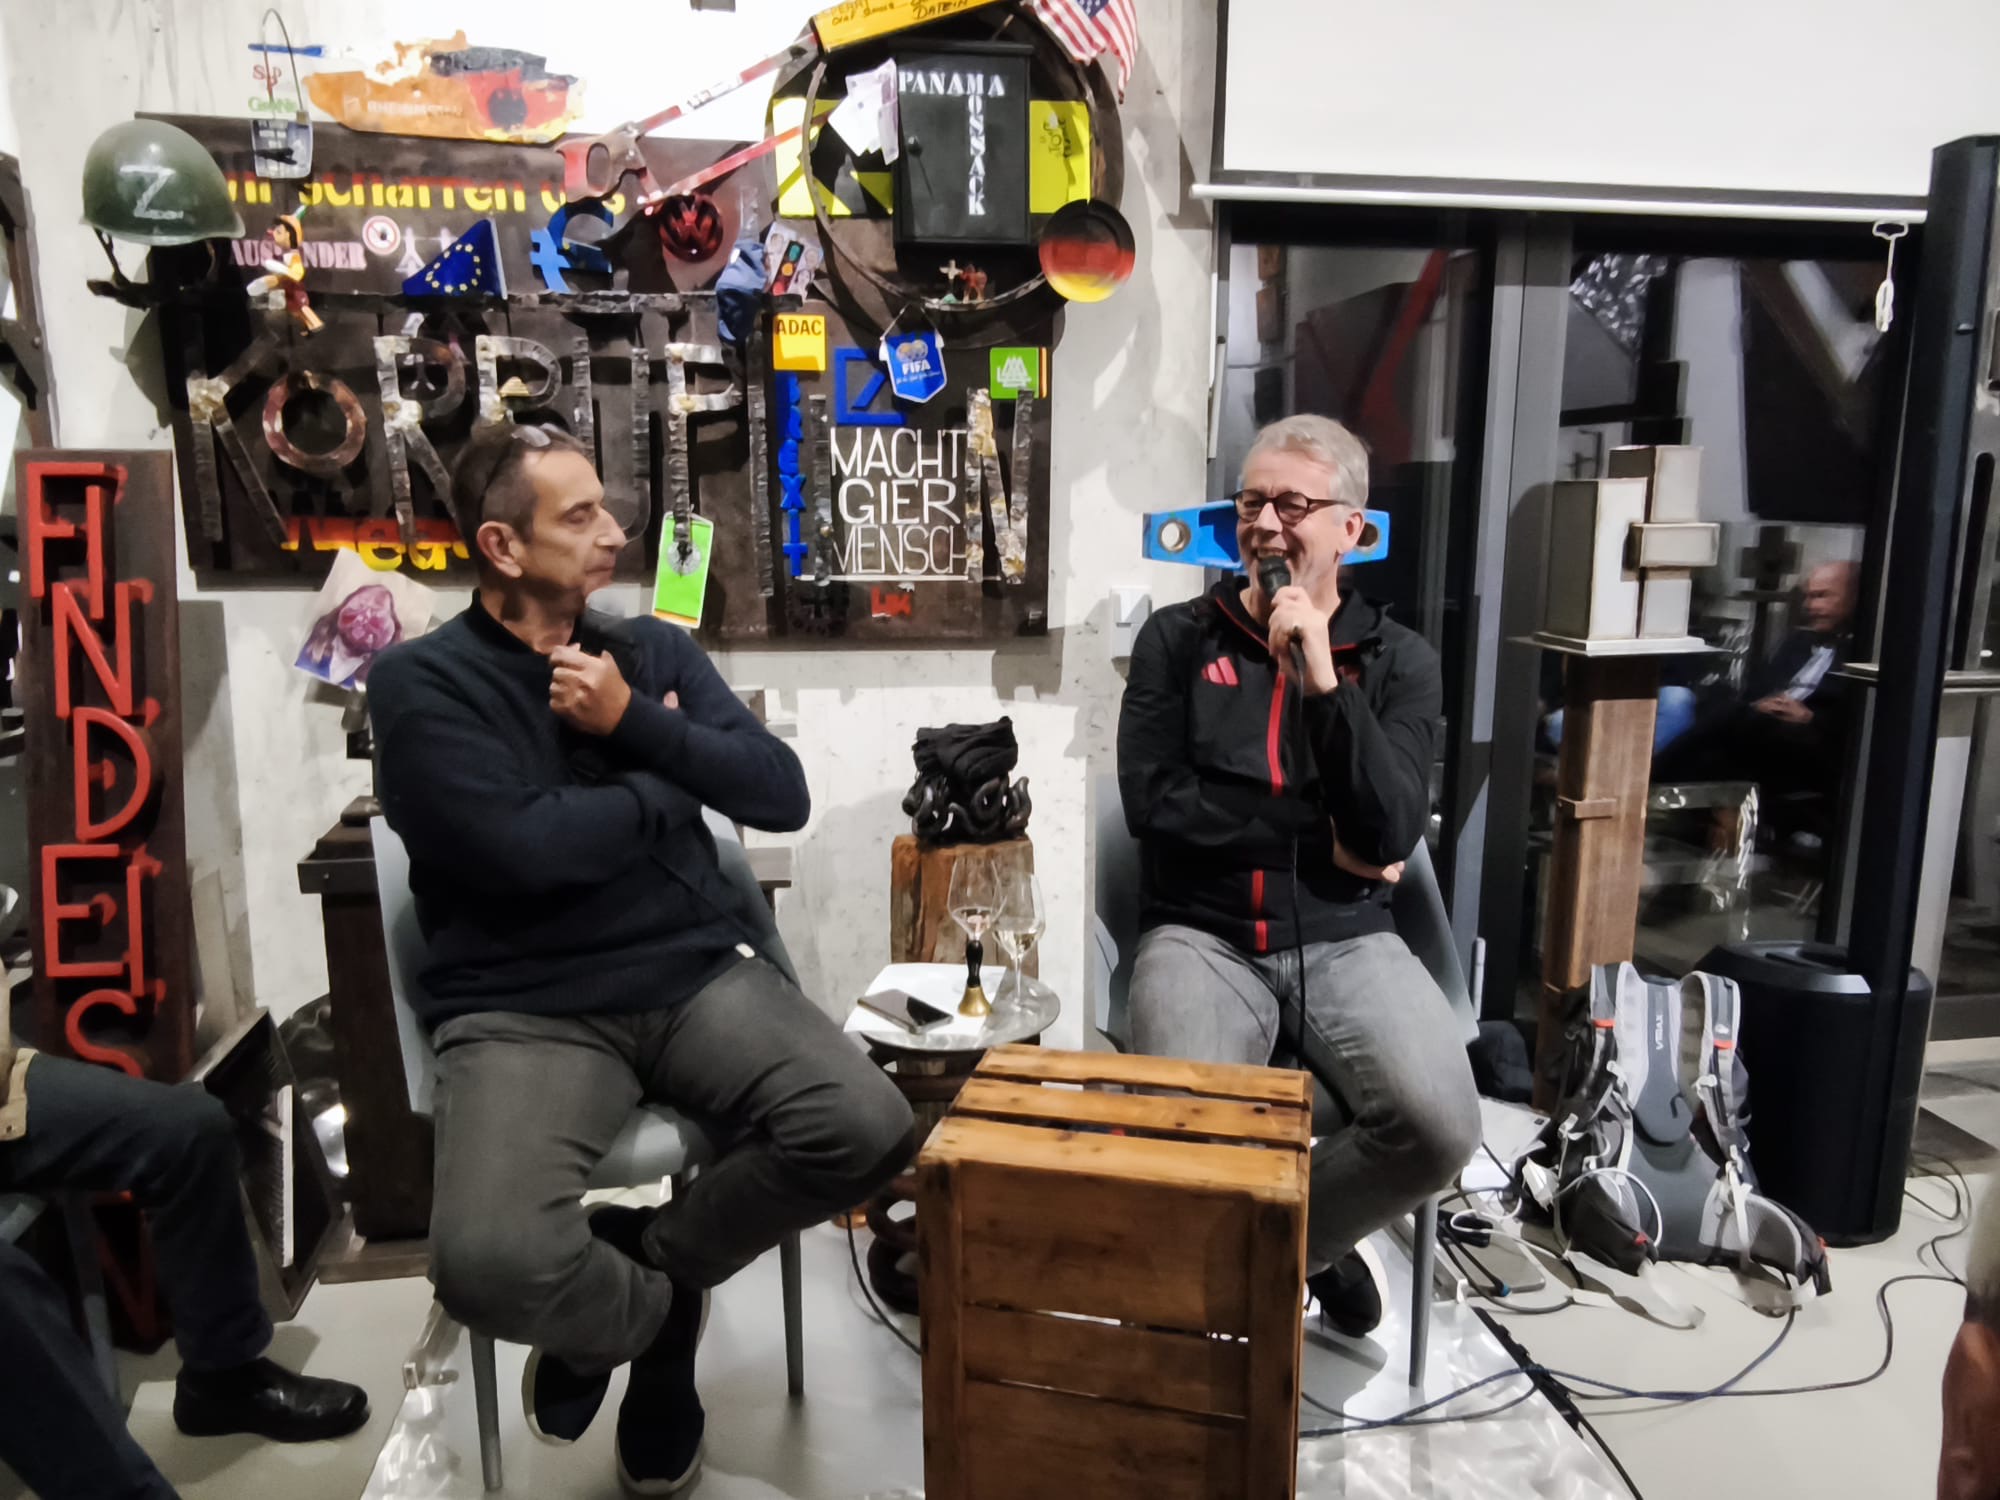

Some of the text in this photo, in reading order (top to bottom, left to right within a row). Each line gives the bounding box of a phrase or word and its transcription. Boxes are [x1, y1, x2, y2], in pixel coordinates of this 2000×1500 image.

[899, 70, 1005, 97] PANAMA
[231, 239, 368, 271] AUSNDER
[775, 319, 823, 336] ADAC
[901, 358, 932, 376] FIFA
[829, 426, 968, 479] MACHT
[838, 478, 961, 525] GIER
